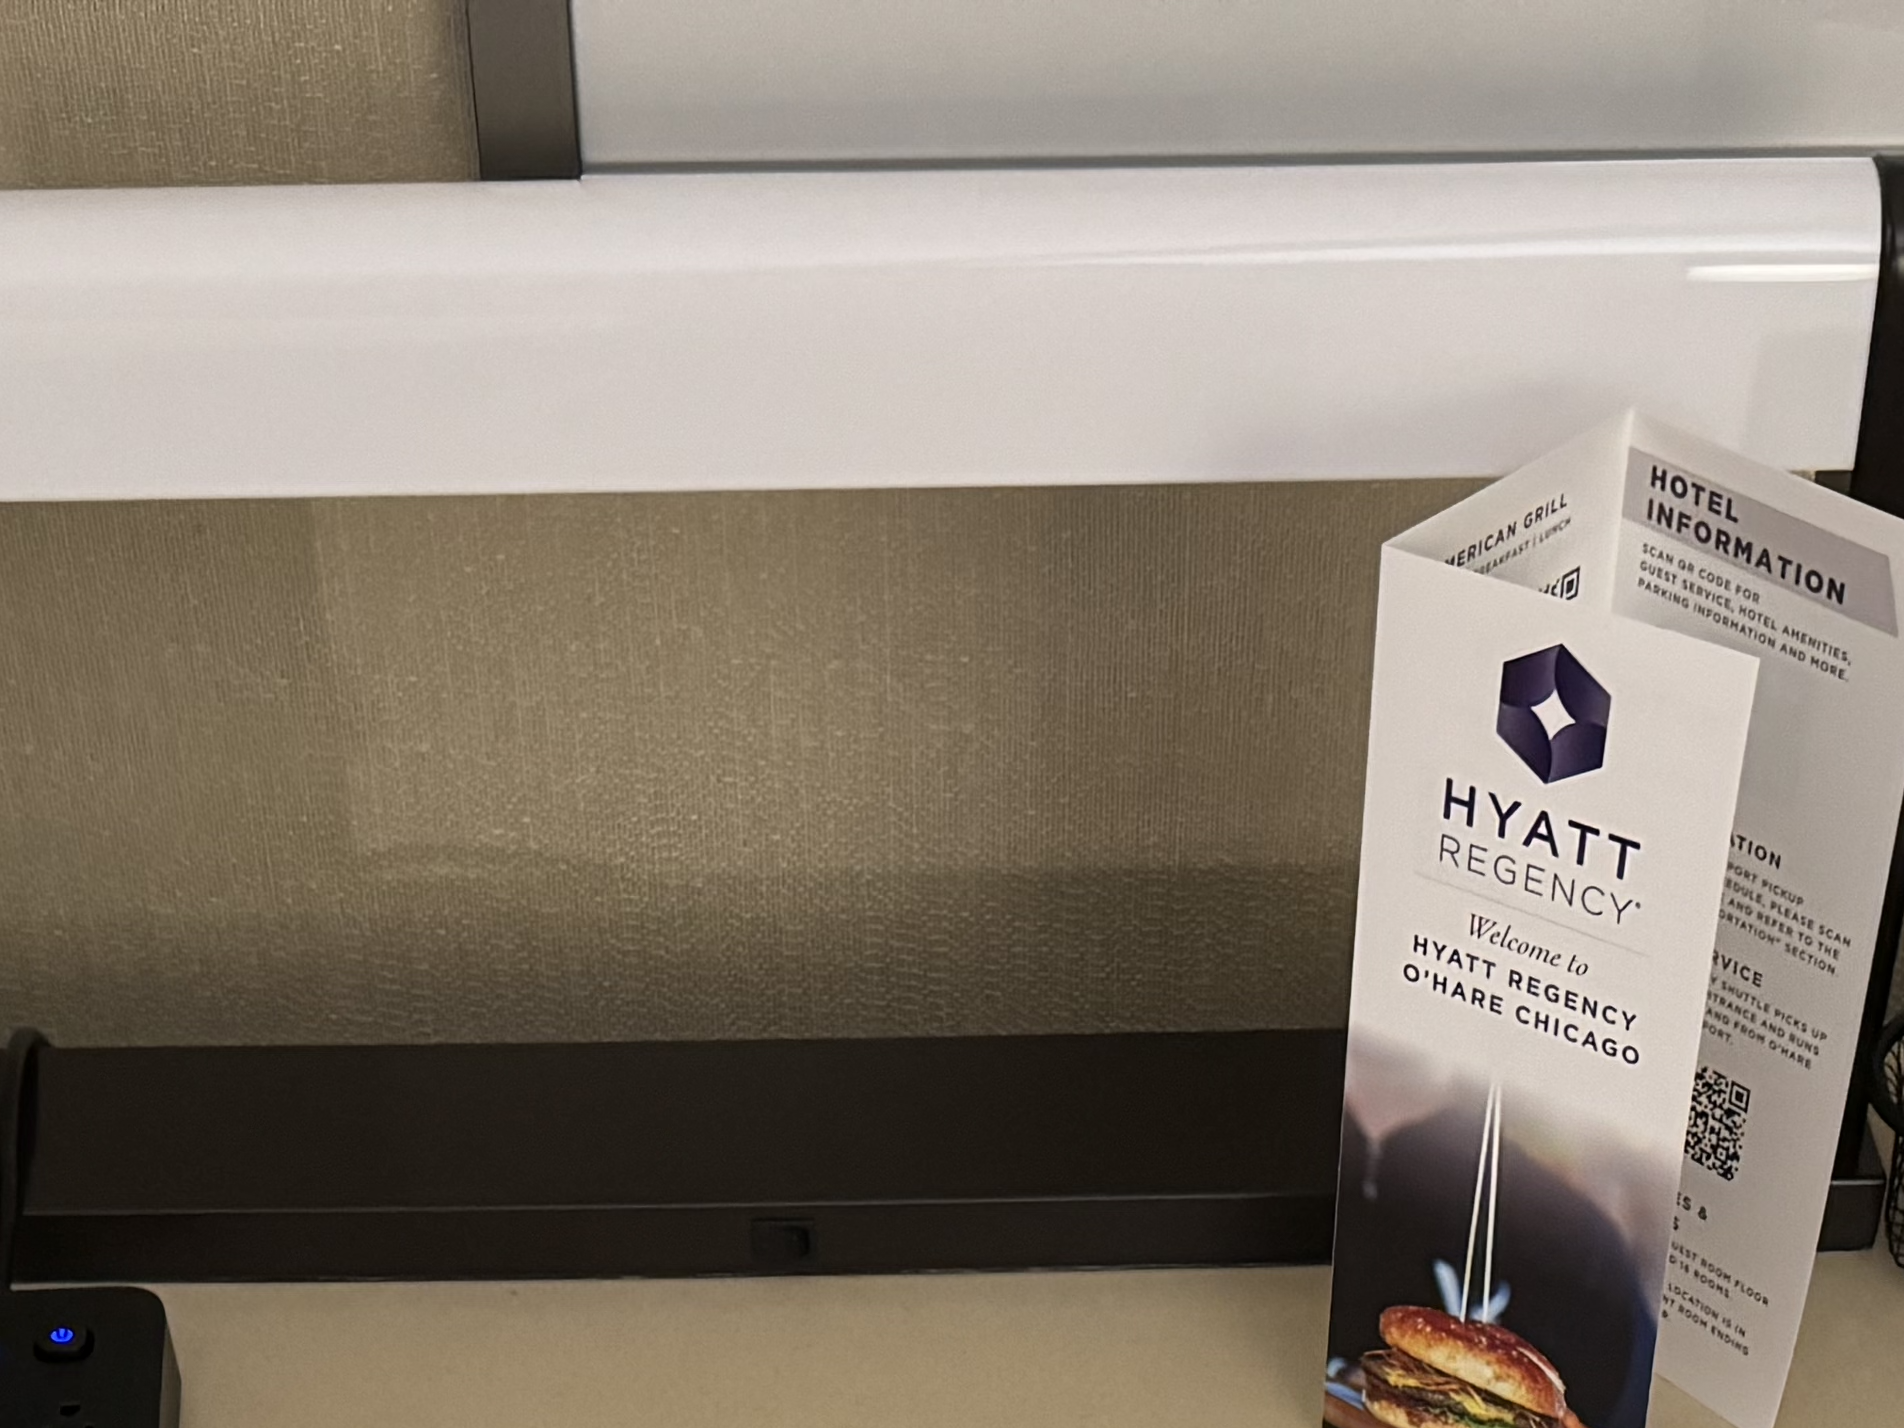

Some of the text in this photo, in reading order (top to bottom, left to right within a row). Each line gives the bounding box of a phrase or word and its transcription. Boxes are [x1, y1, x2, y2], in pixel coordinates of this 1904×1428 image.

[1524, 493, 1568, 529] GRILL
[1650, 465, 1738, 524] HOTEL
[1642, 543, 1674, 565] SCAN
[1698, 567, 1731, 592] CODE
[1735, 582, 1761, 605] FOR
[1647, 498, 1846, 606] INFORMATION
[1637, 577, 1690, 610] PARKING
[1693, 602, 1776, 649] INFORMATION
[1780, 643, 1807, 663] AND
[1640, 560, 1678, 586] GUEST
[1738, 604, 1778, 632] HOTEL
[1443, 777, 1642, 882] HYATT
[1762, 879, 1805, 906] PICKUP
[1469, 913, 1590, 977] Welcome to
[1727, 898, 1841, 961] AND REFER TO THE
[1770, 900, 1815, 931] PLEASE
[1819, 925, 1852, 948] SCAN
[1413, 934, 1638, 1032] HYATT REGENCY
[1722, 980, 1828, 1041] SHUTTLE PICKS UP
[1403, 963, 1640, 1065] O'HARE CHICAGO
[1705, 1008, 1730, 1026] AND
[1733, 1021, 1766, 1045] FROM
[1760, 1019, 1786, 1038] AND
[1788, 1033, 1820, 1056] RUNS
[1700, 1257, 1731, 1284] ROOM
[1734, 1279, 1769, 1308] FLOOR
[1677, 1303, 1708, 1329] ROOM
